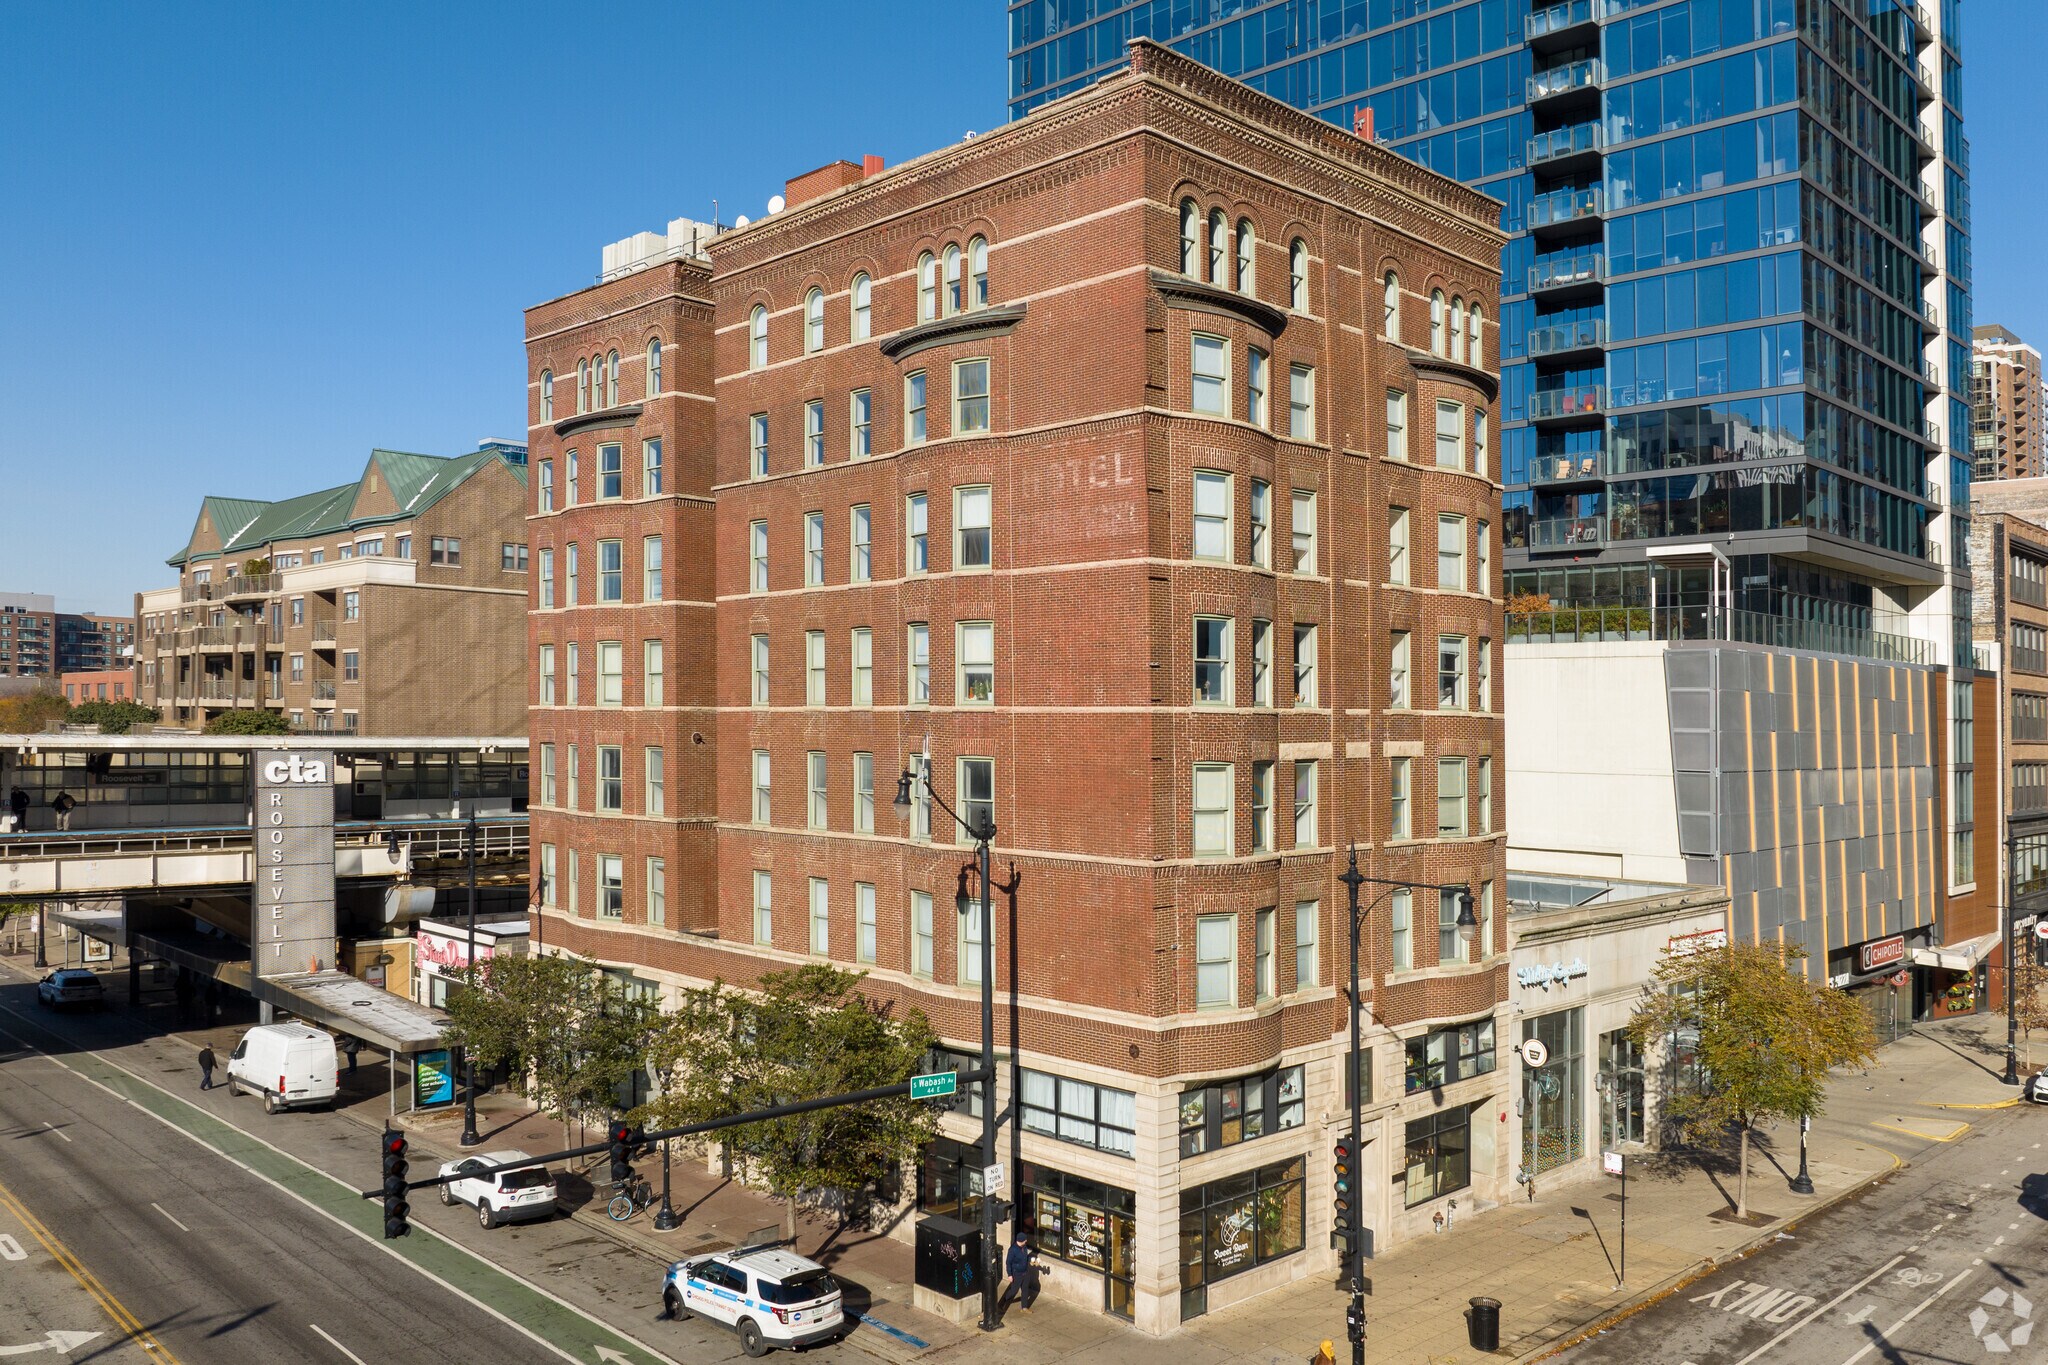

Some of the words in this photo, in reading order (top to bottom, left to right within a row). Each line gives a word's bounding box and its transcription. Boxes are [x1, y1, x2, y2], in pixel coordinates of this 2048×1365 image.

[264, 754, 327, 784] cta
[101, 774, 143, 783] Roosevelt
[270, 793, 284, 957] ROOSEVELT
[1872, 941, 1903, 961] CHIPOTLE
[913, 1081, 917, 1089] S
[919, 1076, 945, 1087] Wabash
[987, 1184, 994, 1192] ON
[995, 1180, 1004, 1188] RED
[989, 1175, 1001, 1183] TURN
[1068, 1236, 1084, 1248] Sweet
[1213, 1247, 1232, 1260] Sweet
[1232, 1243, 1249, 1253] Bean
[1688, 1280, 1817, 1323] ONLY
